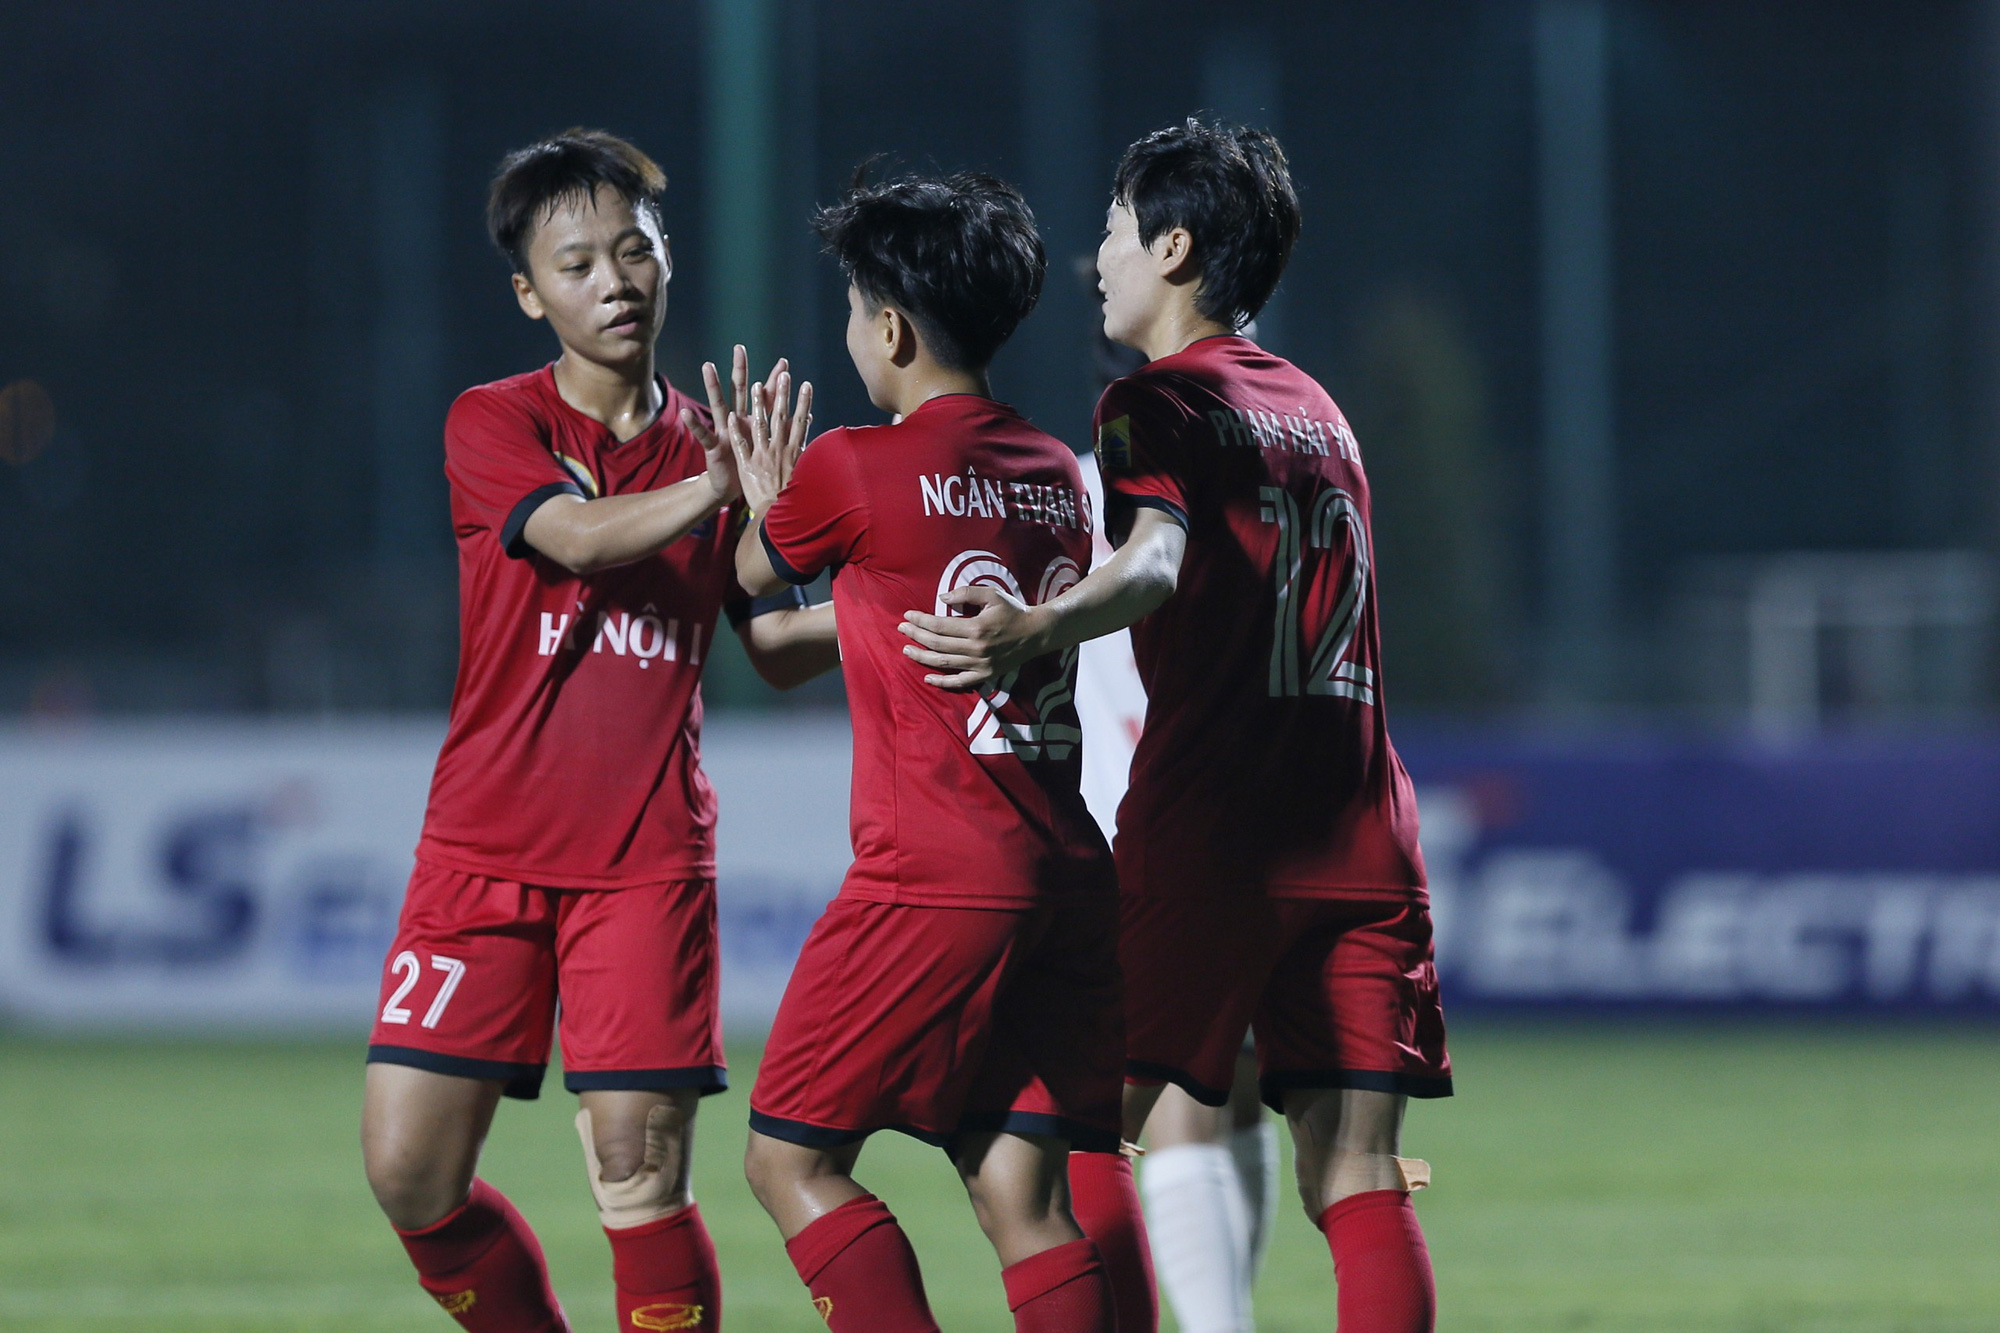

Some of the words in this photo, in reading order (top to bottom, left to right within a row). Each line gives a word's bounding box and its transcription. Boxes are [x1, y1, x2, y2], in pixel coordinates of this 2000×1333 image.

[919, 465, 1007, 519] NGÂN
[1259, 487, 1374, 706] 12
[593, 602, 679, 669] NỘI
[381, 949, 466, 1030] 27
